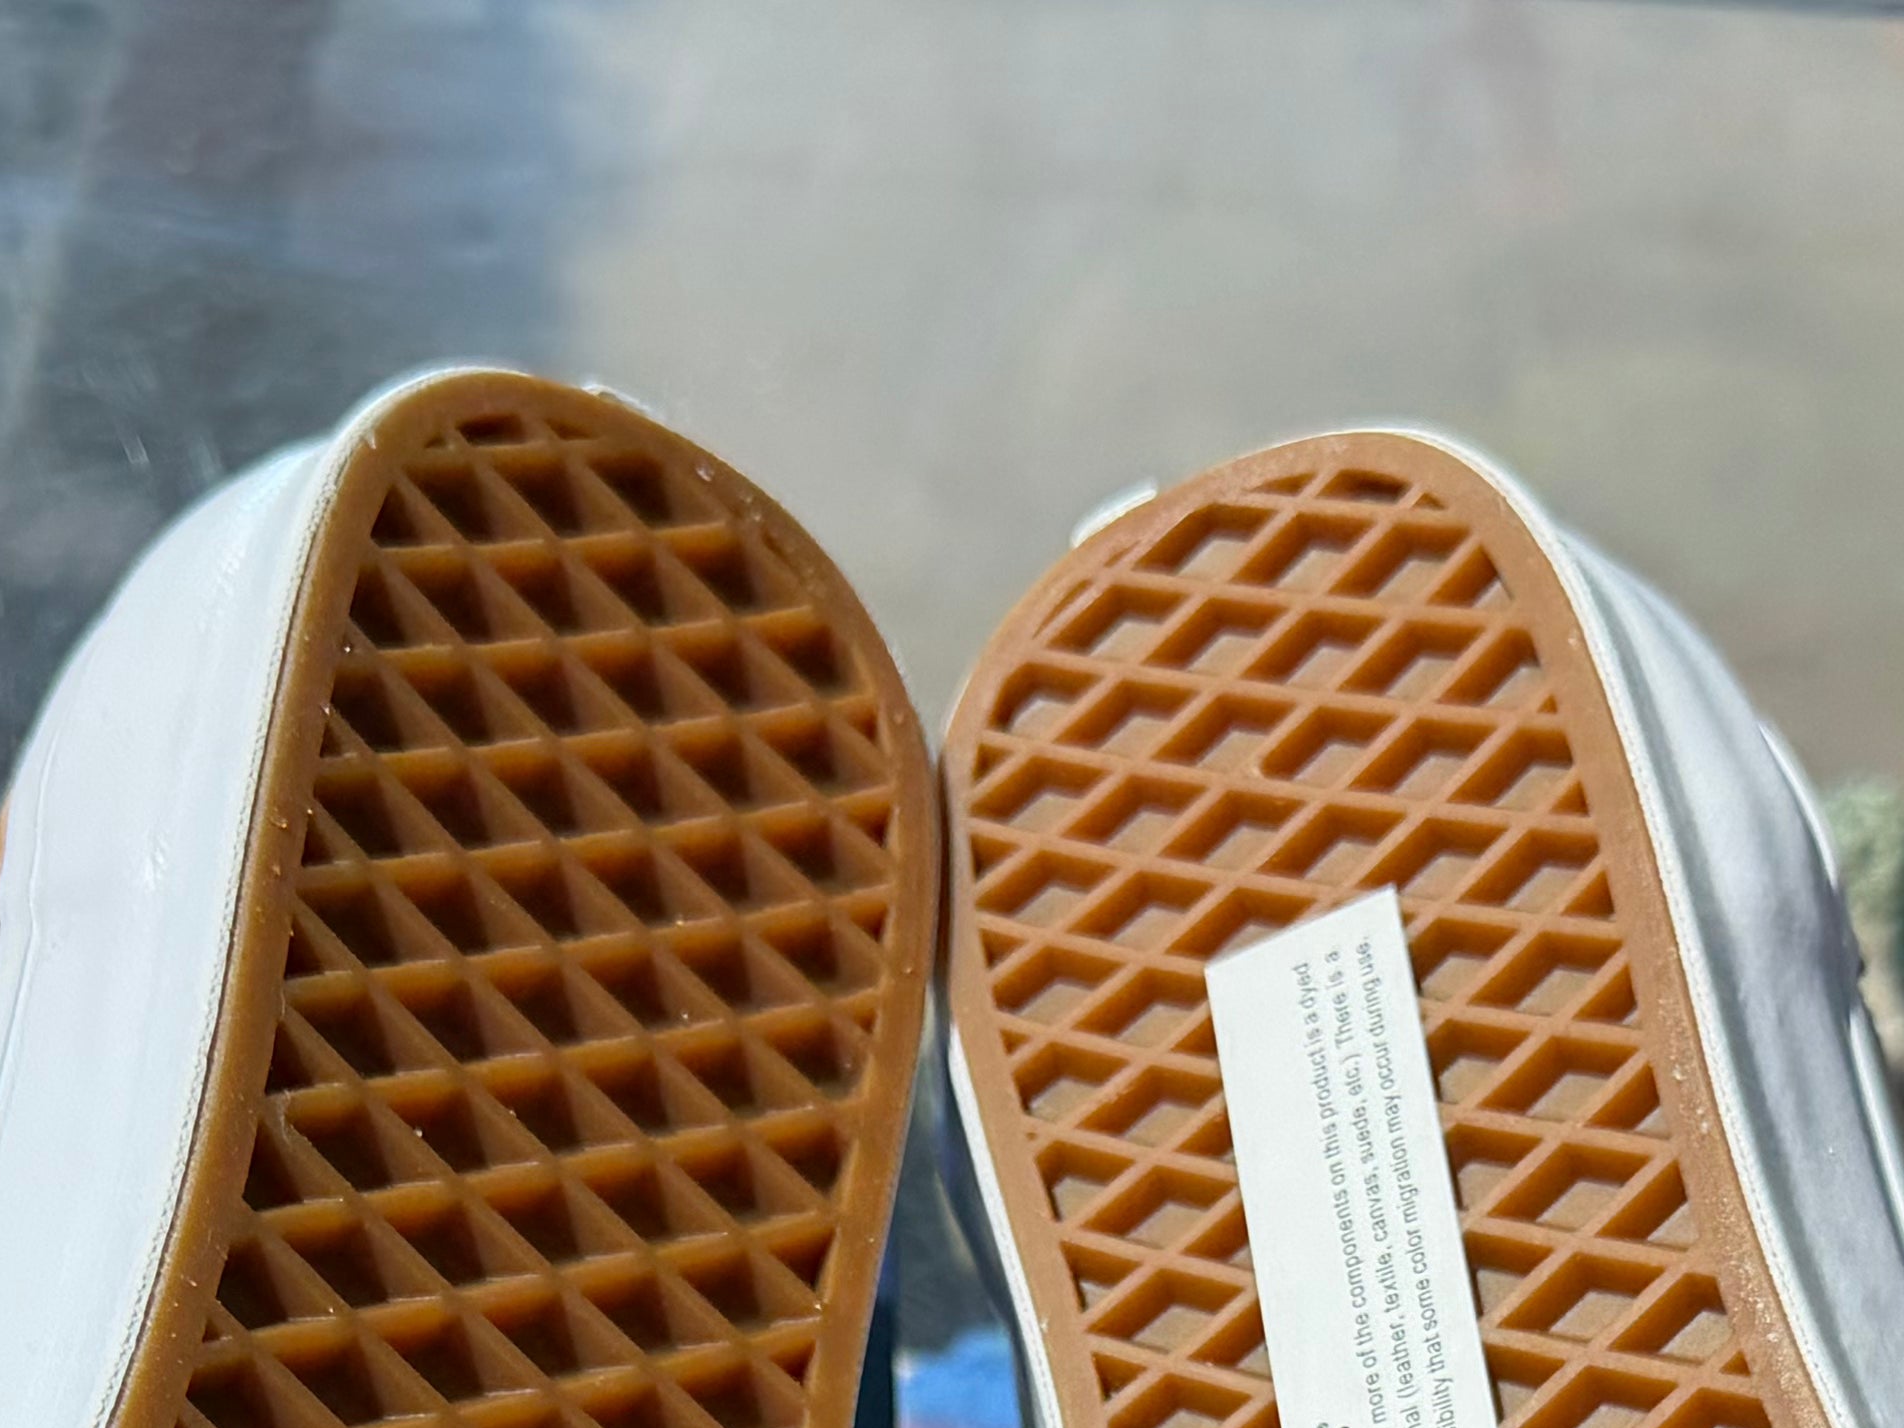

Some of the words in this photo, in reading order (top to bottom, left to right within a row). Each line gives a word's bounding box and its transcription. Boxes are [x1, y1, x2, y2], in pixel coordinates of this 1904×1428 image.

[1324, 950, 1340, 963] a
[1291, 961, 1318, 1009] dyed
[1324, 969, 1344, 989] is
[1303, 1011, 1319, 1025] a
[1331, 991, 1354, 1049] There
[1361, 976, 1385, 1037] during
[1303, 1027, 1323, 1046] is
[1306, 1046, 1339, 1119] product
[1372, 1040, 1395, 1091] occur
[1383, 1094, 1402, 1133] may
[1319, 1121, 1341, 1159] this
[1328, 1160, 1346, 1186] on
[1389, 1135, 1419, 1223] migration
[1333, 1188, 1367, 1308] components
[1404, 1228, 1427, 1274] color
[1415, 1277, 1438, 1331] some
[1353, 1312, 1373, 1345] the
[1355, 1348, 1377, 1368] of
[1422, 1332, 1445, 1373] that
[1365, 1371, 1387, 1424] more
